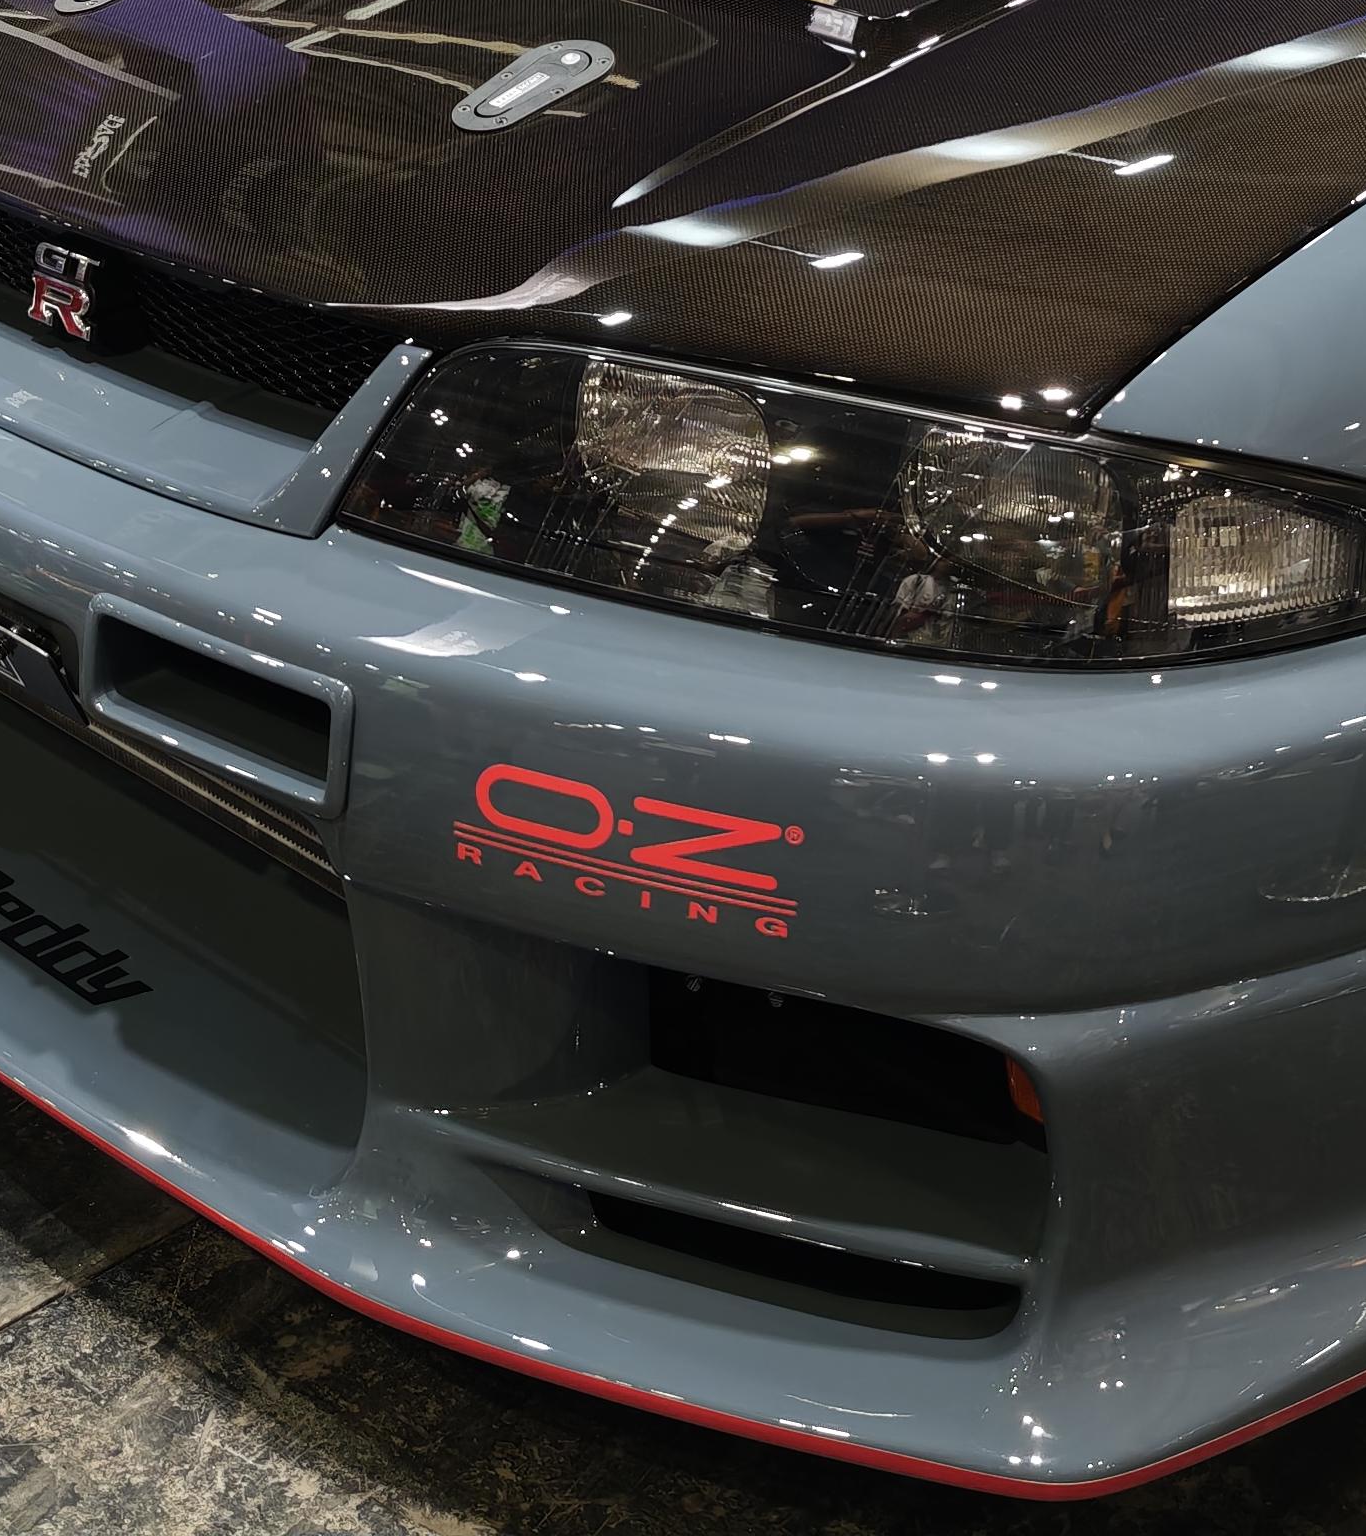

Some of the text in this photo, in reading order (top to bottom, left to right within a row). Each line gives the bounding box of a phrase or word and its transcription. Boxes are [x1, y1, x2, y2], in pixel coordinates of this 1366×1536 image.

[35, 242, 101, 282] GT
[27, 268, 91, 342] R
[457, 841, 789, 939] RACING
